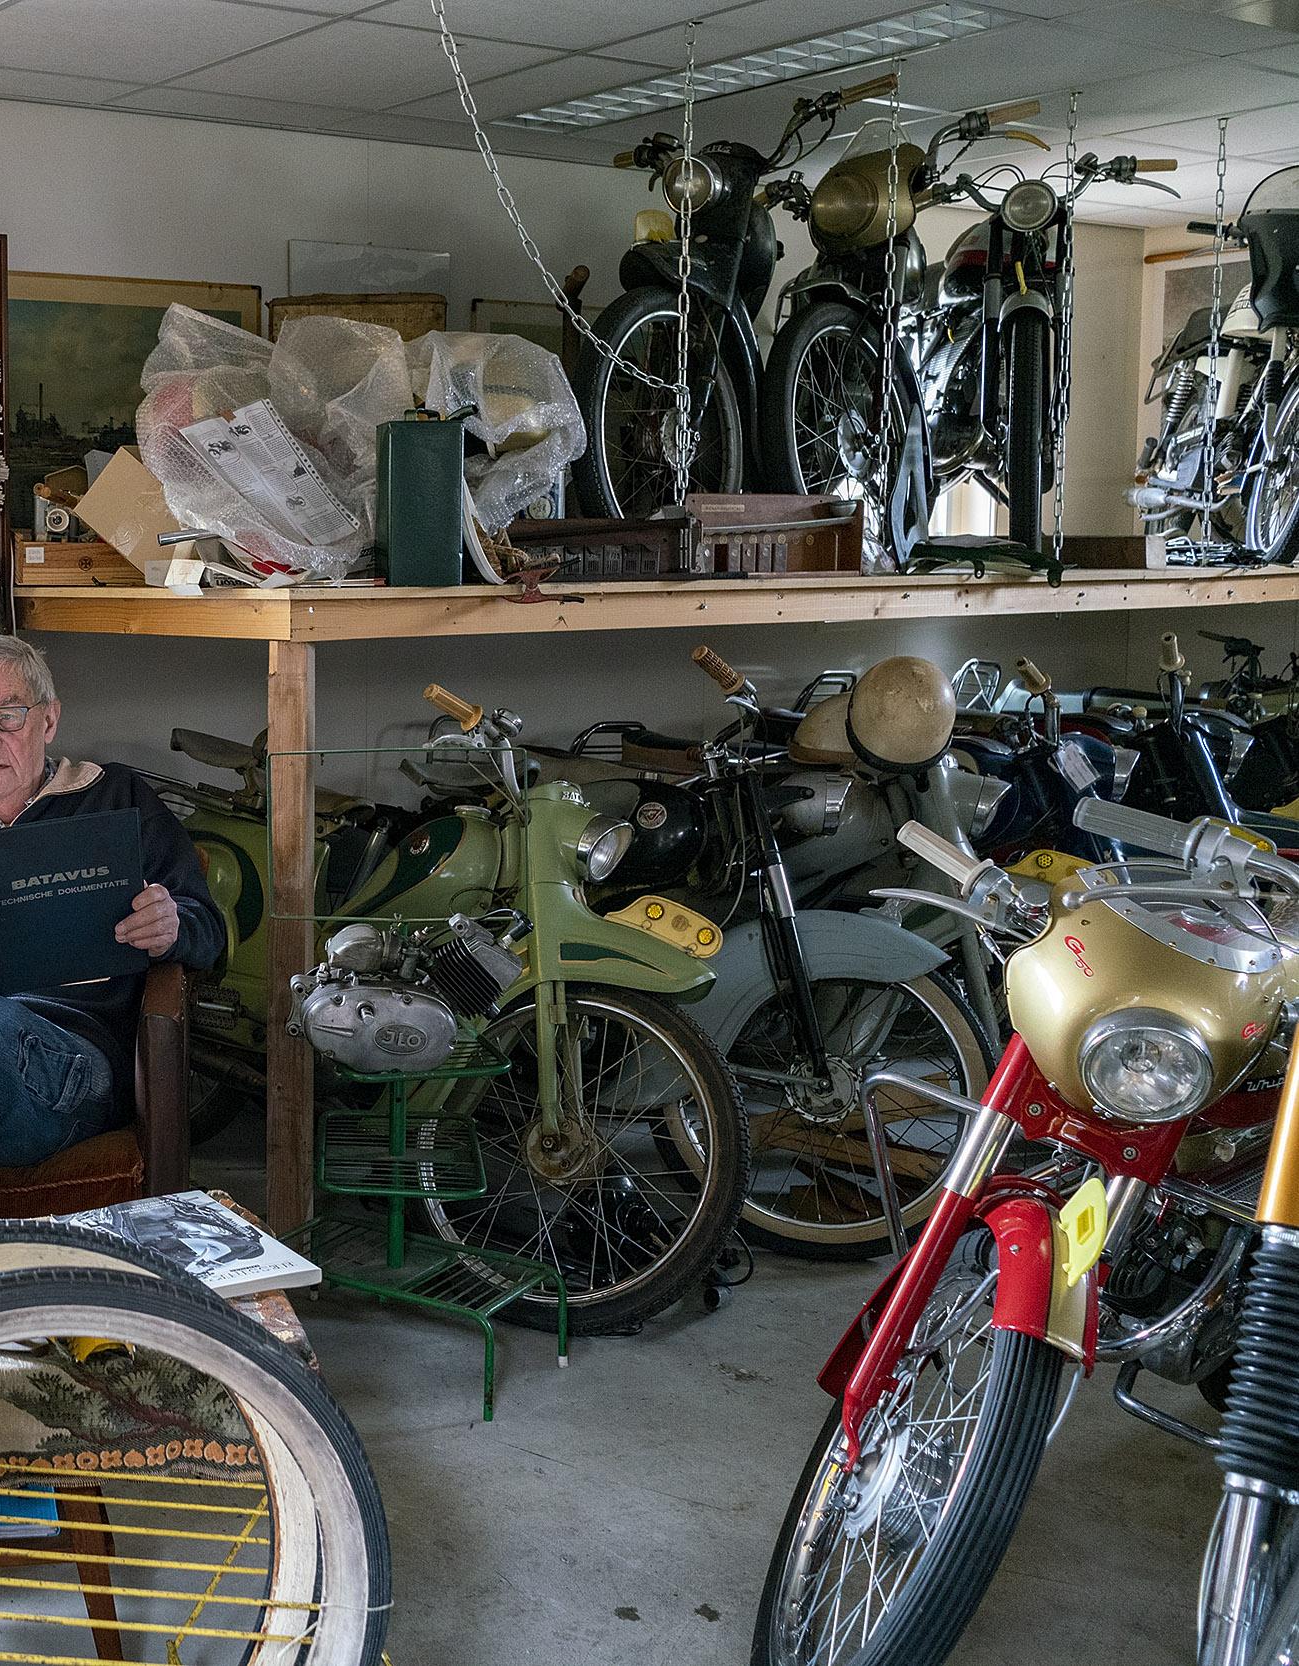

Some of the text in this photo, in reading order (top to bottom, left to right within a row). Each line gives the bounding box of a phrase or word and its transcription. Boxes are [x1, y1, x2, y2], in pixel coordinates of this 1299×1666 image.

[11, 866, 110, 890] BATAVUS
[58, 879, 129, 895] DOKUMENTATIE
[381, 1030, 421, 1047] JLO
[1247, 1077, 1286, 1092] Whip
